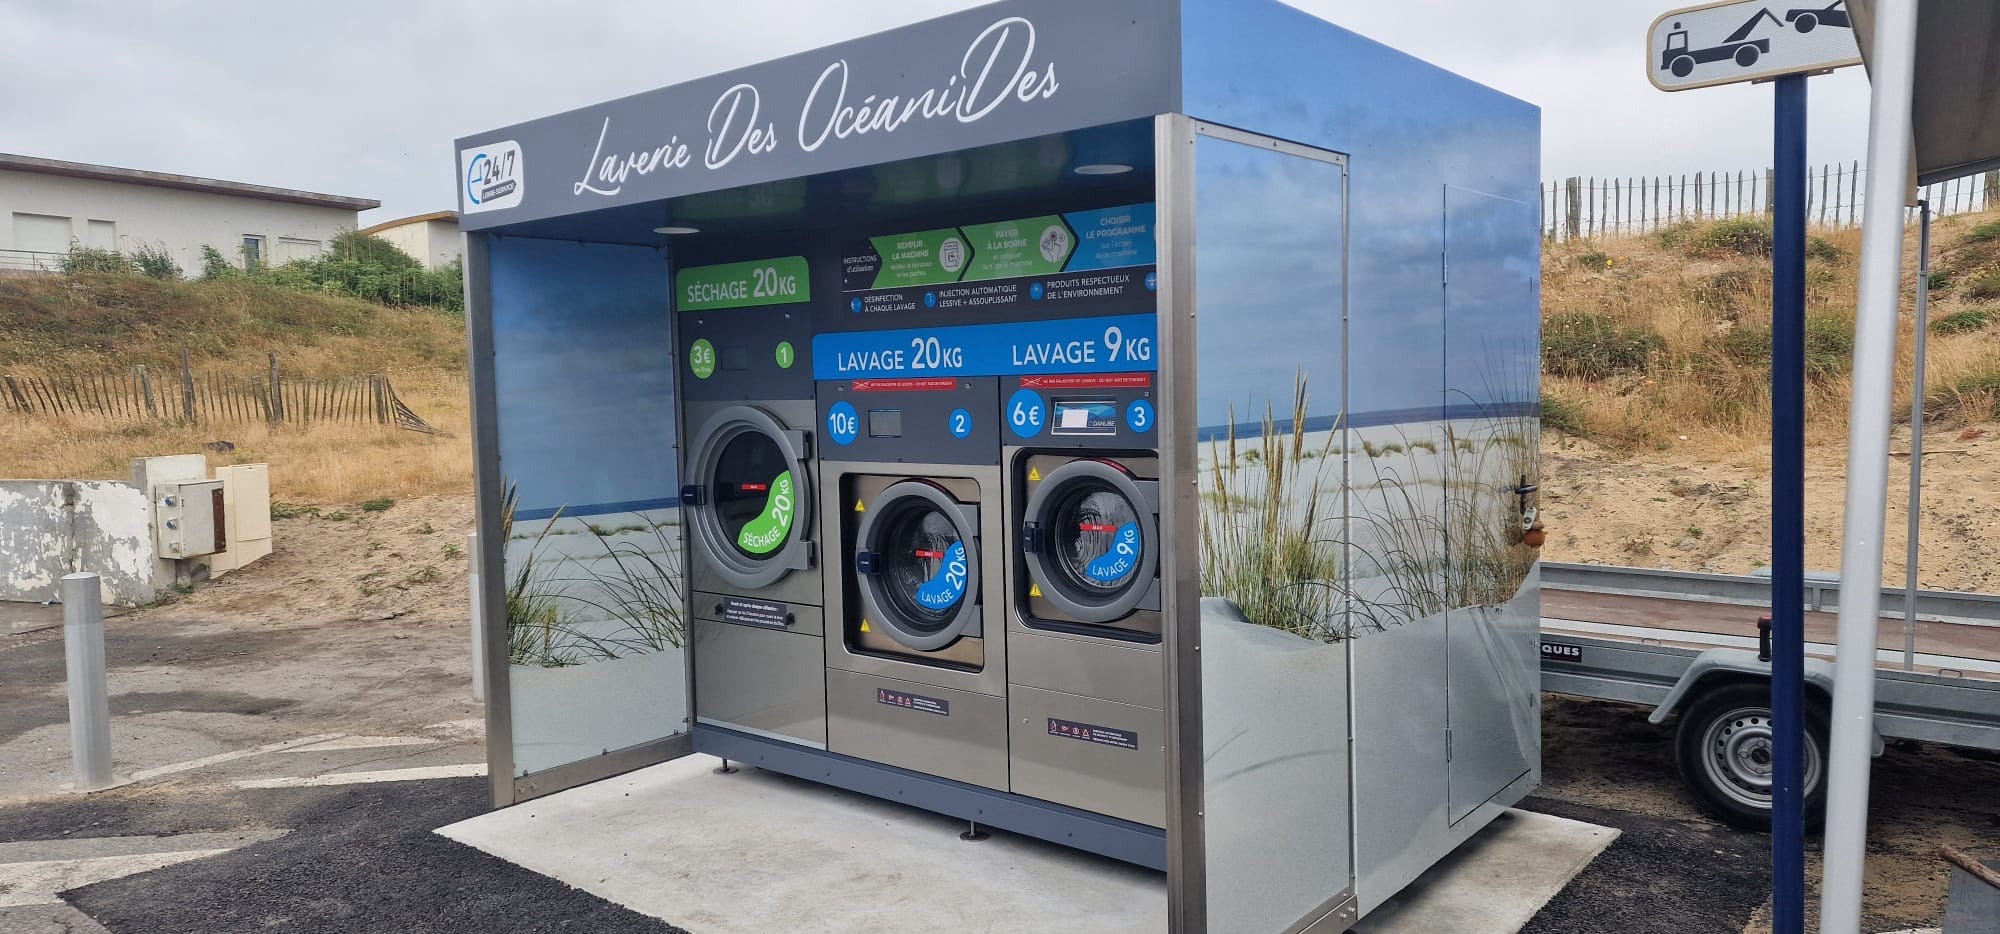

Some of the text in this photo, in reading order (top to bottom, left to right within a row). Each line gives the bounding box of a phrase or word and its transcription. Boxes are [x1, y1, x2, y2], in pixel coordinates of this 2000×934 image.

[574, 16, 1059, 196] Laverie Des OcéaniDes
[484, 150, 516, 186] 24/7
[1100, 215, 1132, 226] CHOISIR
[995, 229, 1018, 239] PAYER
[1085, 225, 1147, 240] LE PROGRAMME
[896, 240, 923, 251] REMPLIR
[986, 239, 1029, 250] À LA BORNE
[844, 254, 878, 265] INSTRUCTIONS
[892, 249, 929, 261] LA MACHINE
[1047, 274, 1130, 289] PRODUITS RESPECTUEUX
[687, 280, 748, 303] SÉCHAGE
[864, 293, 903, 303] DÉSINFECTION
[940, 285, 1017, 298] INJECTION AUTOMATIQUE
[1047, 286, 1124, 300] DE L'ENVIRONNEMENT
[864, 302, 916, 313] À CHAQUE LAVAGE
[940, 299, 961, 308] LESSIVE
[968, 295, 1018, 306] ASSOUPLISSANT
[780, 347, 788, 363] 1
[838, 350, 905, 371] LAVAGE
[1012, 340, 1096, 366] LAVAGE
[830, 412, 856, 434] 10€
[1134, 406, 1146, 426] 3
[955, 415, 965, 433] 2
[743, 526, 781, 547] SÉCHAGE
[1092, 558, 1128, 577] LAVAGE
[921, 588, 954, 605] LAVAGE
